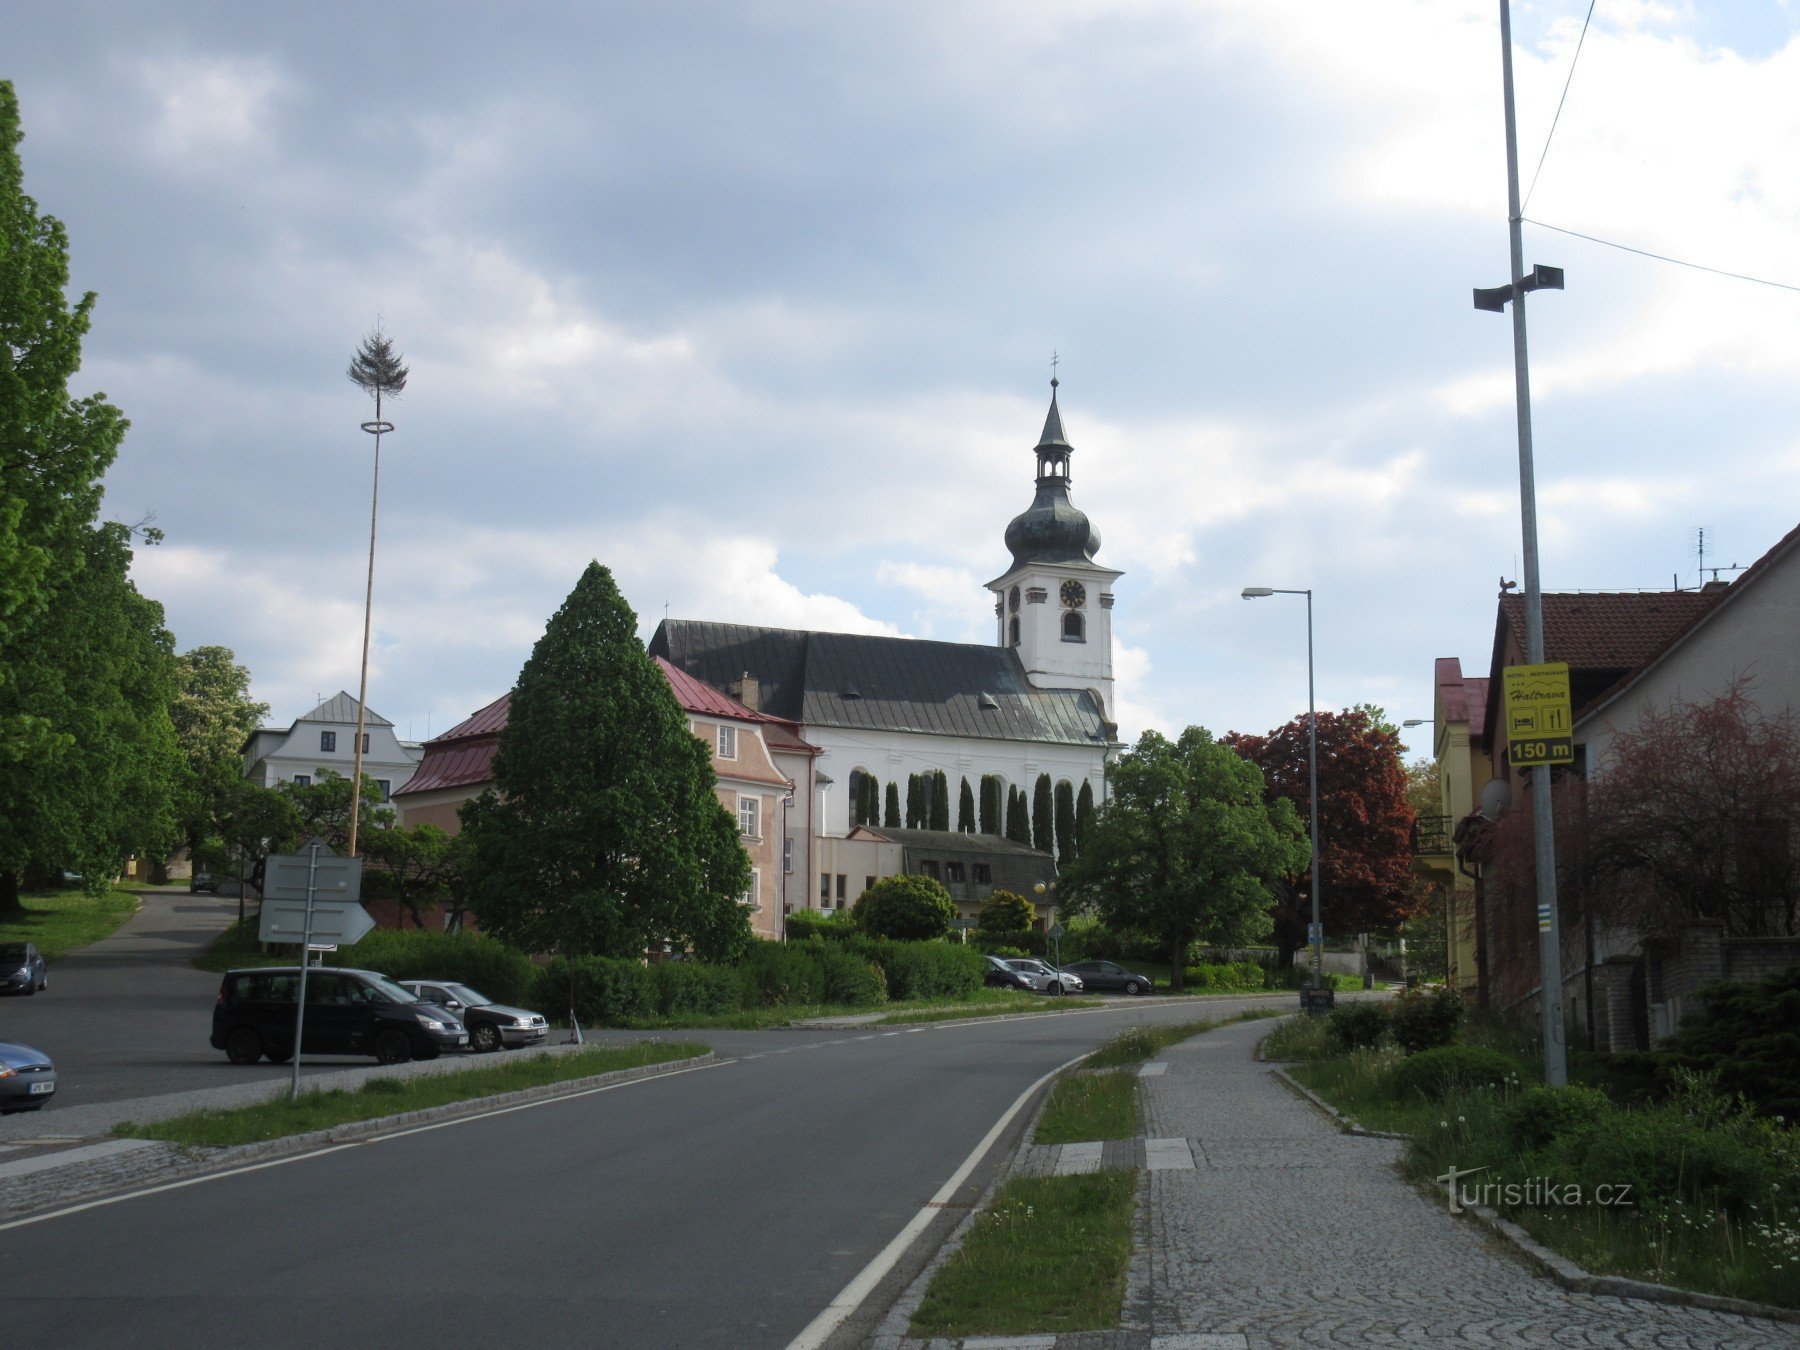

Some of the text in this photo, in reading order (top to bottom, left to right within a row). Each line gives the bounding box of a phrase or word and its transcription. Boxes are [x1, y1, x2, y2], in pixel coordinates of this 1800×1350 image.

[1510, 690, 1566, 701] Haltrava
[1514, 742, 1569, 758] 150 m
